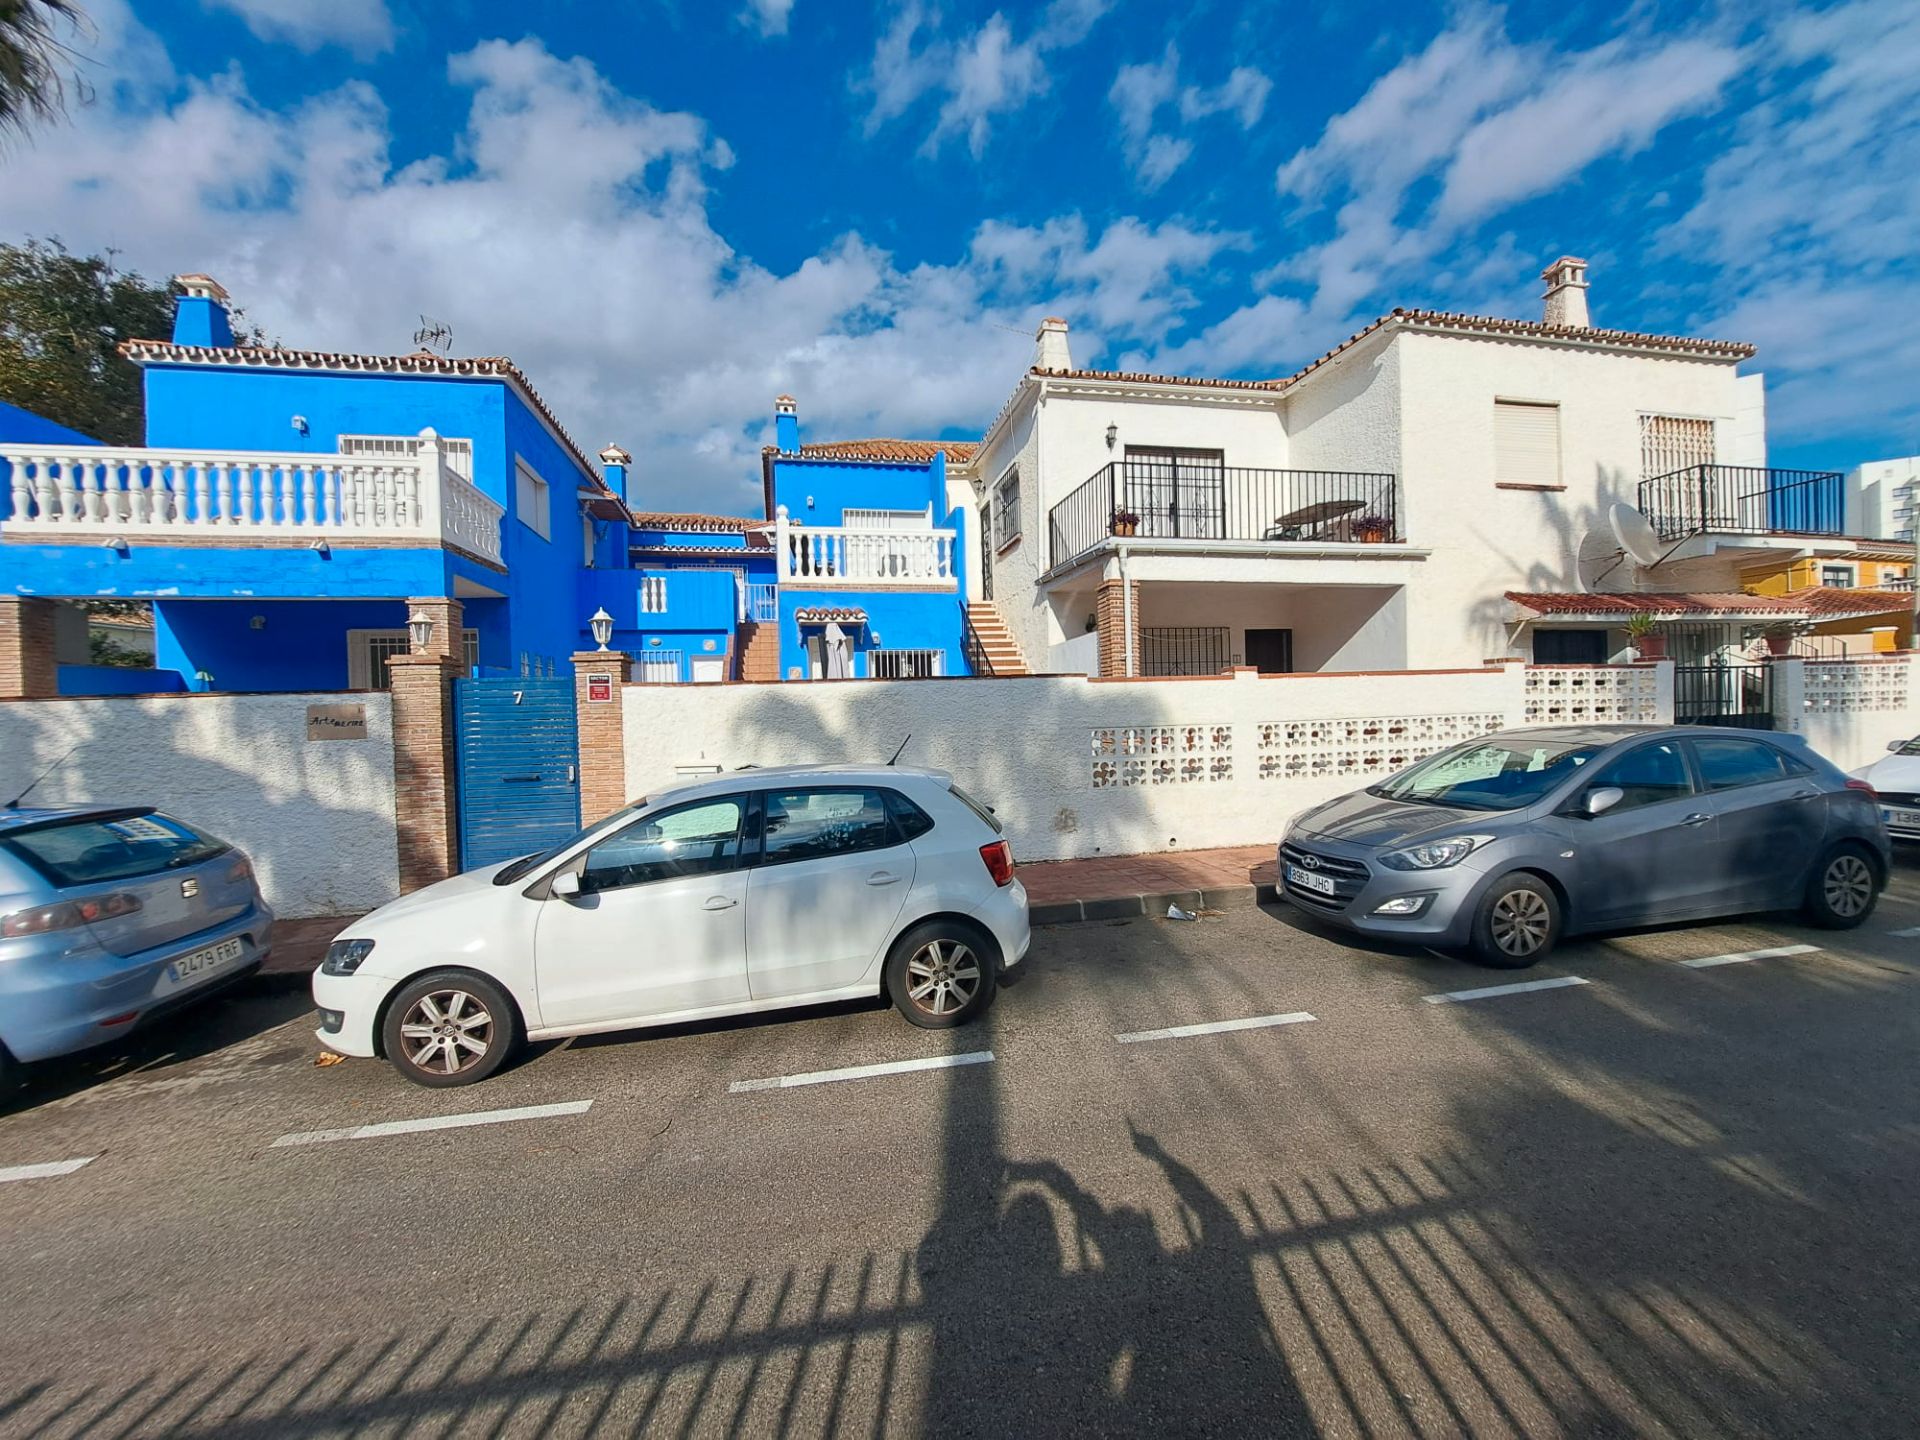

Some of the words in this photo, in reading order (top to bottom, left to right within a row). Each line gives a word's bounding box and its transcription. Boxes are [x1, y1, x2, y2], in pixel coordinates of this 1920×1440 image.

[512, 690, 523, 705] 7
[1291, 869, 1310, 885] 8963
[1313, 876, 1330, 892] JHC
[178, 951, 215, 976] 2479
[217, 941, 238, 961] FRF
